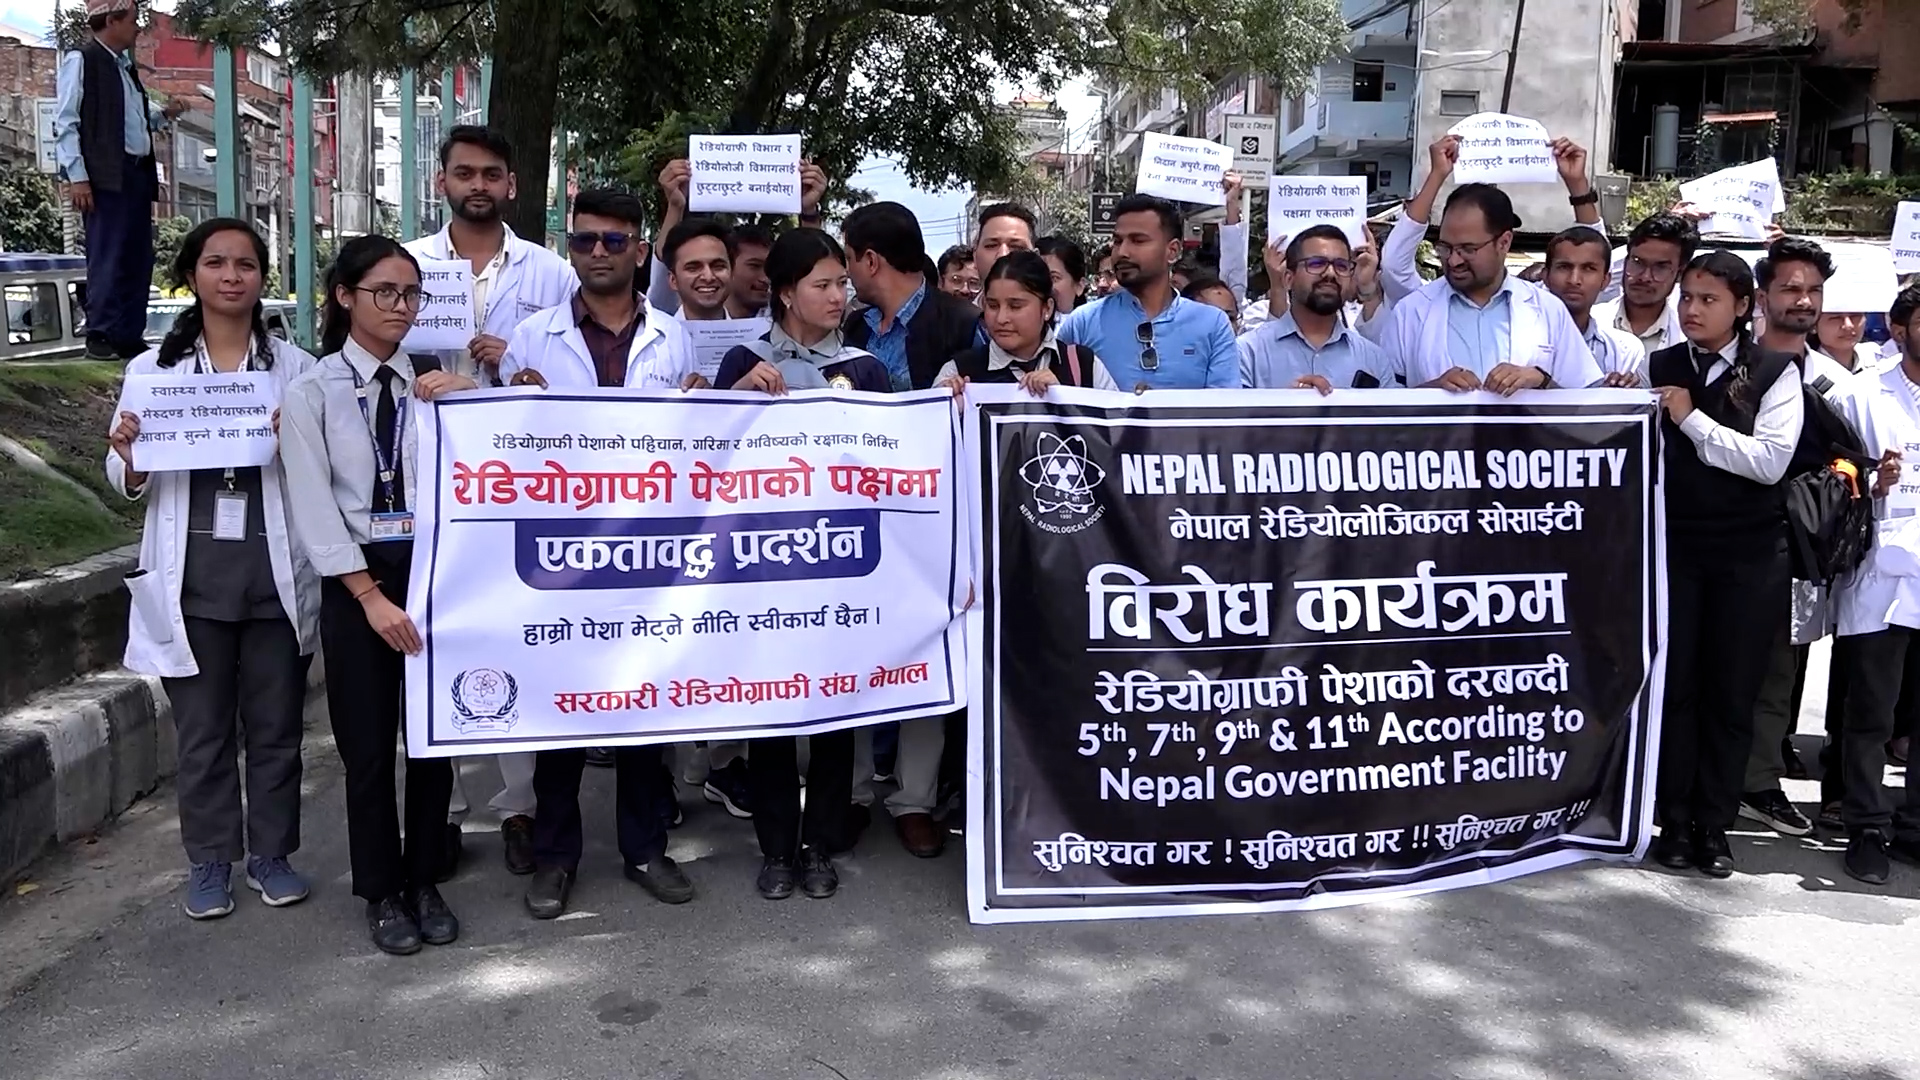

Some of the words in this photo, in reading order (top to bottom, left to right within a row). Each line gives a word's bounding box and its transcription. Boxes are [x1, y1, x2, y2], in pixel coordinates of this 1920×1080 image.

[695, 160, 744, 172] रेडियोलोजी
[749, 161, 796, 174] विभागलाई
[752, 142, 781, 153] विभाग
[786, 145, 793, 153] र
[1278, 184, 1327, 197] रेडियोग्राफी
[1331, 185, 1361, 196] पेशाको
[1283, 209, 1311, 218] पक्षमा
[1316, 206, 1355, 218] एकताको
[455, 271, 463, 281] र
[151, 386, 196, 397] स्वास्थ्य
[203, 382, 255, 396] प्रणालीको
[142, 407, 184, 419] मेरुदण्ड
[191, 404, 267, 418] रेडियोग्राफरको
[139, 430, 177, 442] आवाज
[184, 428, 211, 445] सुन्ने
[218, 427, 240, 439] बेला
[493, 433, 573, 452] रेडियोग्राफी
[577, 434, 626, 451] पेशाको
[631, 434, 687, 453] पहिचान,
[692, 435, 730, 450] गरिमा
[733, 439, 742, 450] र
[747, 432, 808, 449] भविष्यको
[813, 434, 858, 447] रक्षाका
[862, 433, 900, 450] निम्ति
[453, 460, 677, 511] रेडियोग्राफी
[689, 457, 816, 503] पेशाको
[828, 464, 942, 503] पक्षमा
[1121, 453, 1226, 495] NEPAL
[1232, 450, 1482, 494] RADIOLOGICAL
[1486, 449, 1628, 489] SOCIETY
[1019, 503, 1036, 524] NEPAL
[1037, 520, 1086, 534] RADIOLOGICAL
[1084, 504, 1106, 527] SOCIETY
[1168, 508, 1251, 541] नेपाल
[1259, 503, 1470, 539] रेडियोलोजिकल
[1477, 500, 1585, 536] सोसाईटी
[730, 518, 865, 570] प्रदर्शन
[1085, 563, 1273, 643] विरोध
[1294, 560, 1568, 633] कार्यक्रम
[523, 617, 573, 646] हाम्रो
[580, 617, 624, 641] पेशा
[631, 614, 684, 643] मेट्ने
[692, 610, 740, 634] नीति
[748, 605, 830, 632] स्वीकार्य
[834, 602, 870, 629] छैन
[554, 682, 660, 714] सरकारी
[668, 673, 811, 708] रेडियोग्राफी
[868, 661, 929, 689] नेपाल
[1094, 666, 1309, 715] रेडियोग्राफी
[1319, 659, 1436, 706] पेशाको
[1445, 652, 1570, 700] दरबन्दी
[1214, 718, 1261, 755] 9th
[1269, 718, 1298, 752] &
[1306, 711, 1370, 750] 11th
[1377, 704, 1546, 746] According
[1551, 704, 1585, 733] to
[1099, 765, 1215, 808] Nepal
[1224, 755, 1446, 799] Government
[1452, 744, 1567, 783] Facility
[1032, 832, 1157, 873] सुनिश्चत
[1166, 841, 1213, 865] गर
[1240, 829, 1358, 872] सुनिश्चत
[1364, 828, 1405, 854] गर
[1435, 813, 1531, 851] सुनिश्चत
[1533, 807, 1567, 831] गर
